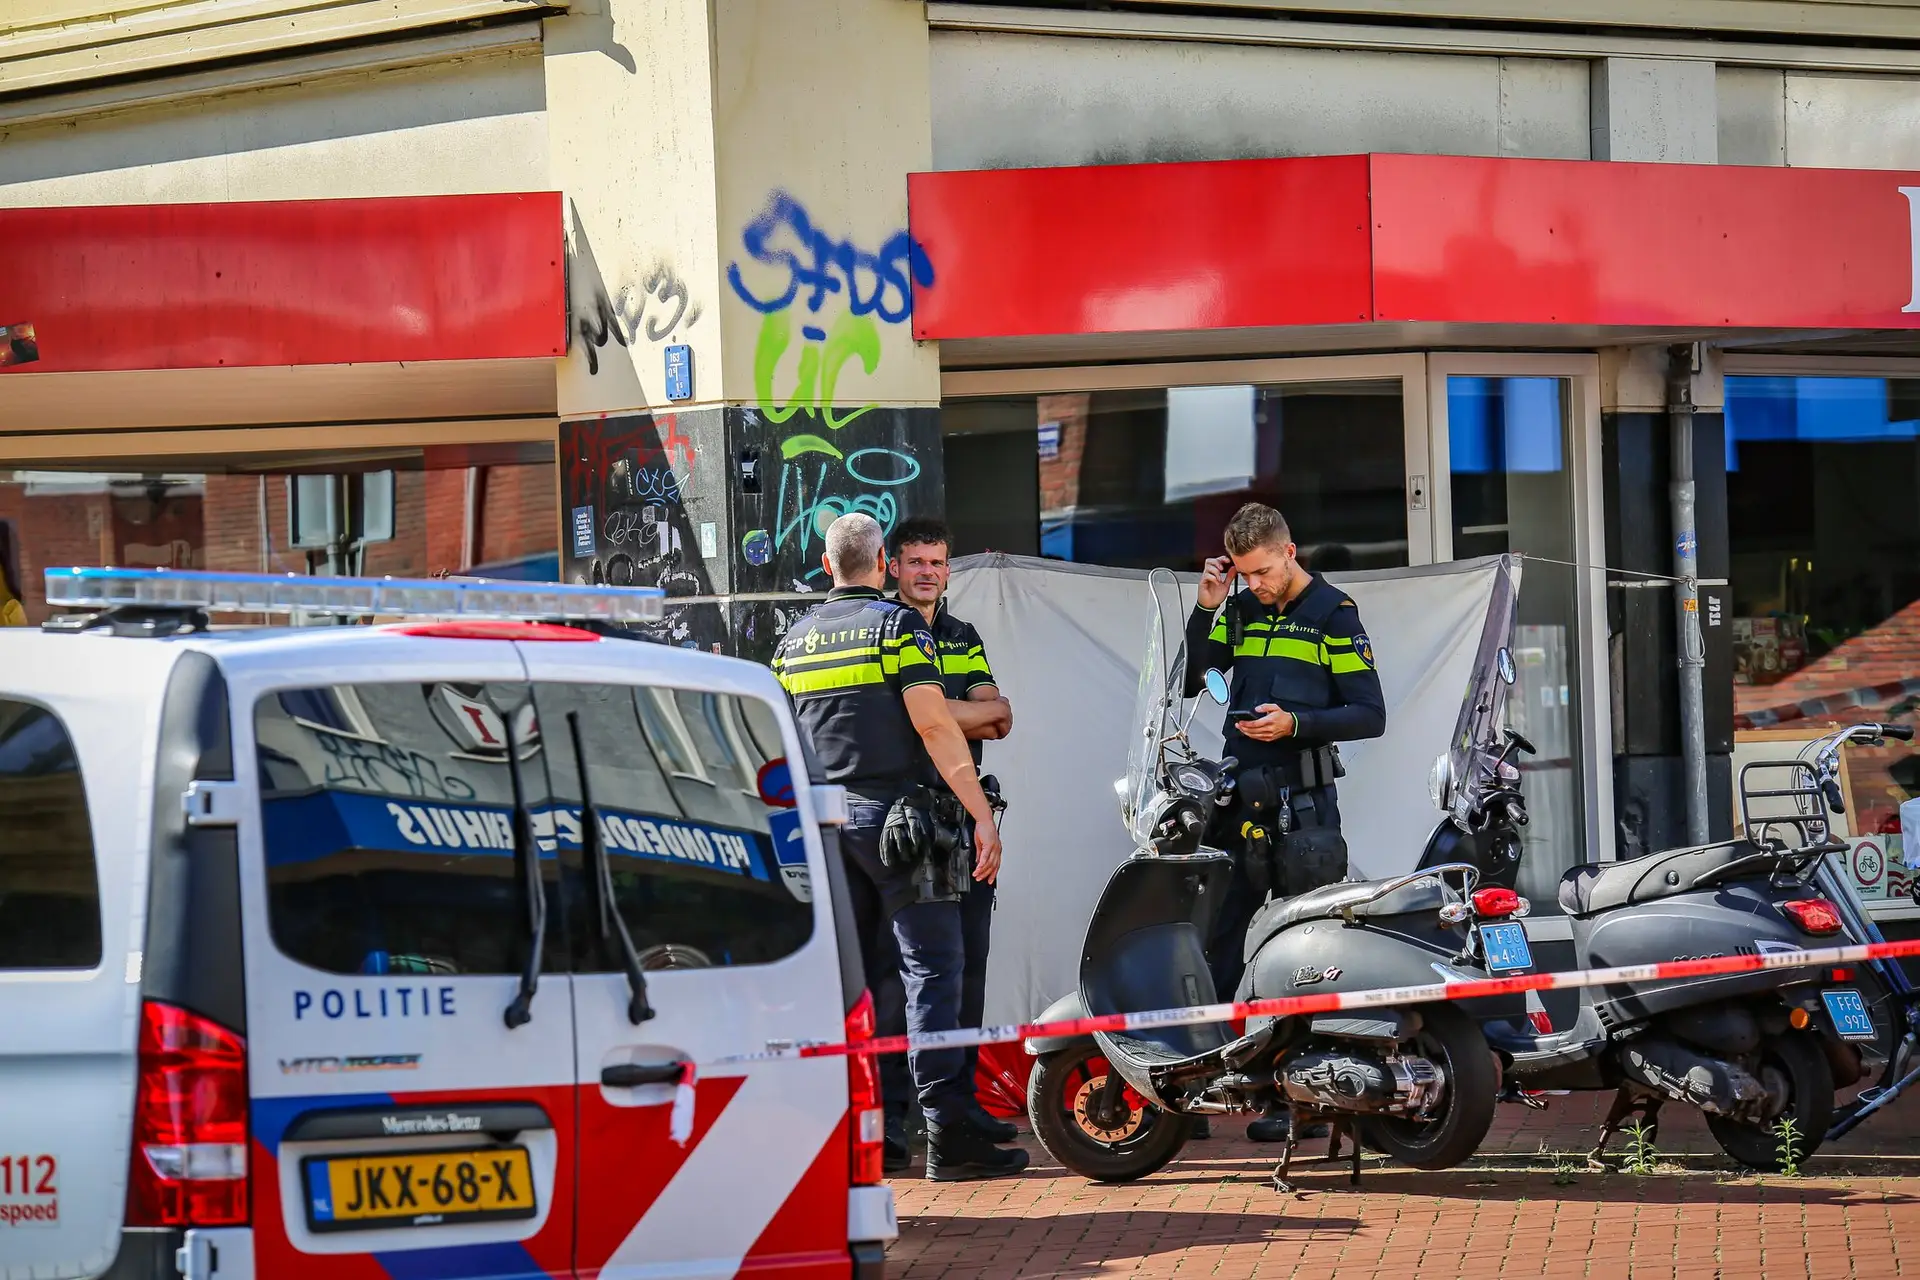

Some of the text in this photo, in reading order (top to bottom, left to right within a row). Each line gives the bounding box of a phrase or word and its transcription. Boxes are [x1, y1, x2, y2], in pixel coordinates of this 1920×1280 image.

[795, 625, 868, 653] POLITIE
[1494, 927, 1521, 945] F38
[1502, 948, 1525, 965] 4RP
[295, 986, 456, 1020] POLITIE
[1836, 996, 1862, 1011] FFG
[1844, 1014, 1869, 1029] 99Z
[382, 1113, 481, 1135] Mercedes-Benz
[0, 1155, 57, 1194] 112
[346, 1159, 518, 1212] JKX-68-X
[0, 1198, 58, 1227] spoed
